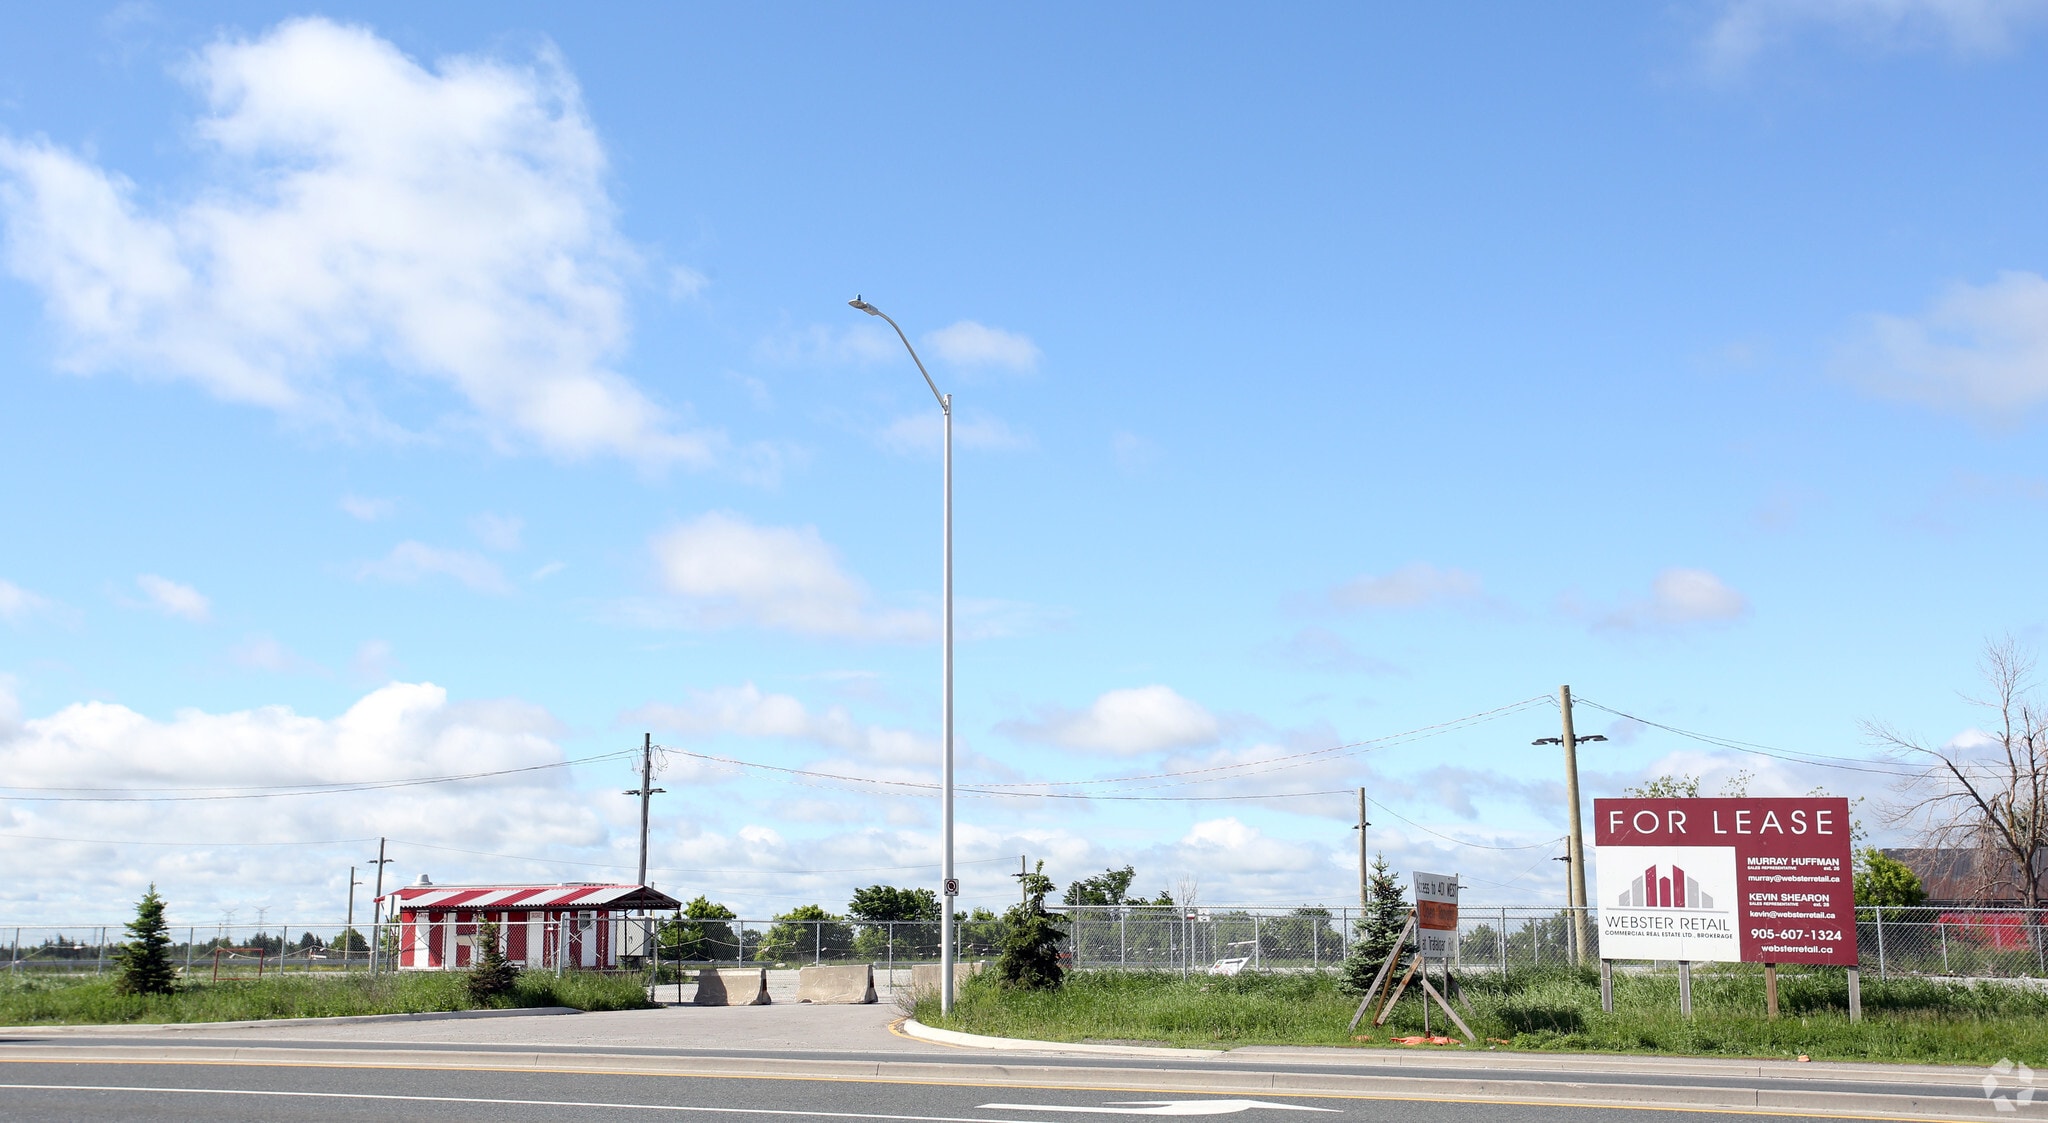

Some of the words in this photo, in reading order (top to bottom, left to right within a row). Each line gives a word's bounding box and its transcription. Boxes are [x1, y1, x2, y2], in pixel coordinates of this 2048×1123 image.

[1609, 810, 1687, 834] FOR
[1713, 810, 1833, 835] LEASE
[1747, 857, 1788, 865] MURRAY
[1791, 858, 1840, 866] HUFFMAN
[1748, 875, 1840, 883] murray@websterretail.ca
[1749, 893, 1778, 901] KEVIN
[1781, 894, 1829, 902] SHEARON
[1749, 911, 1836, 919] kevin@websterretail.ca
[1605, 916, 1674, 929] WEBSTER
[1680, 917, 1730, 931] RETAIL
[1751, 929, 1842, 941] 905-607-1324
[1761, 945, 1833, 953] websterretail.ca
